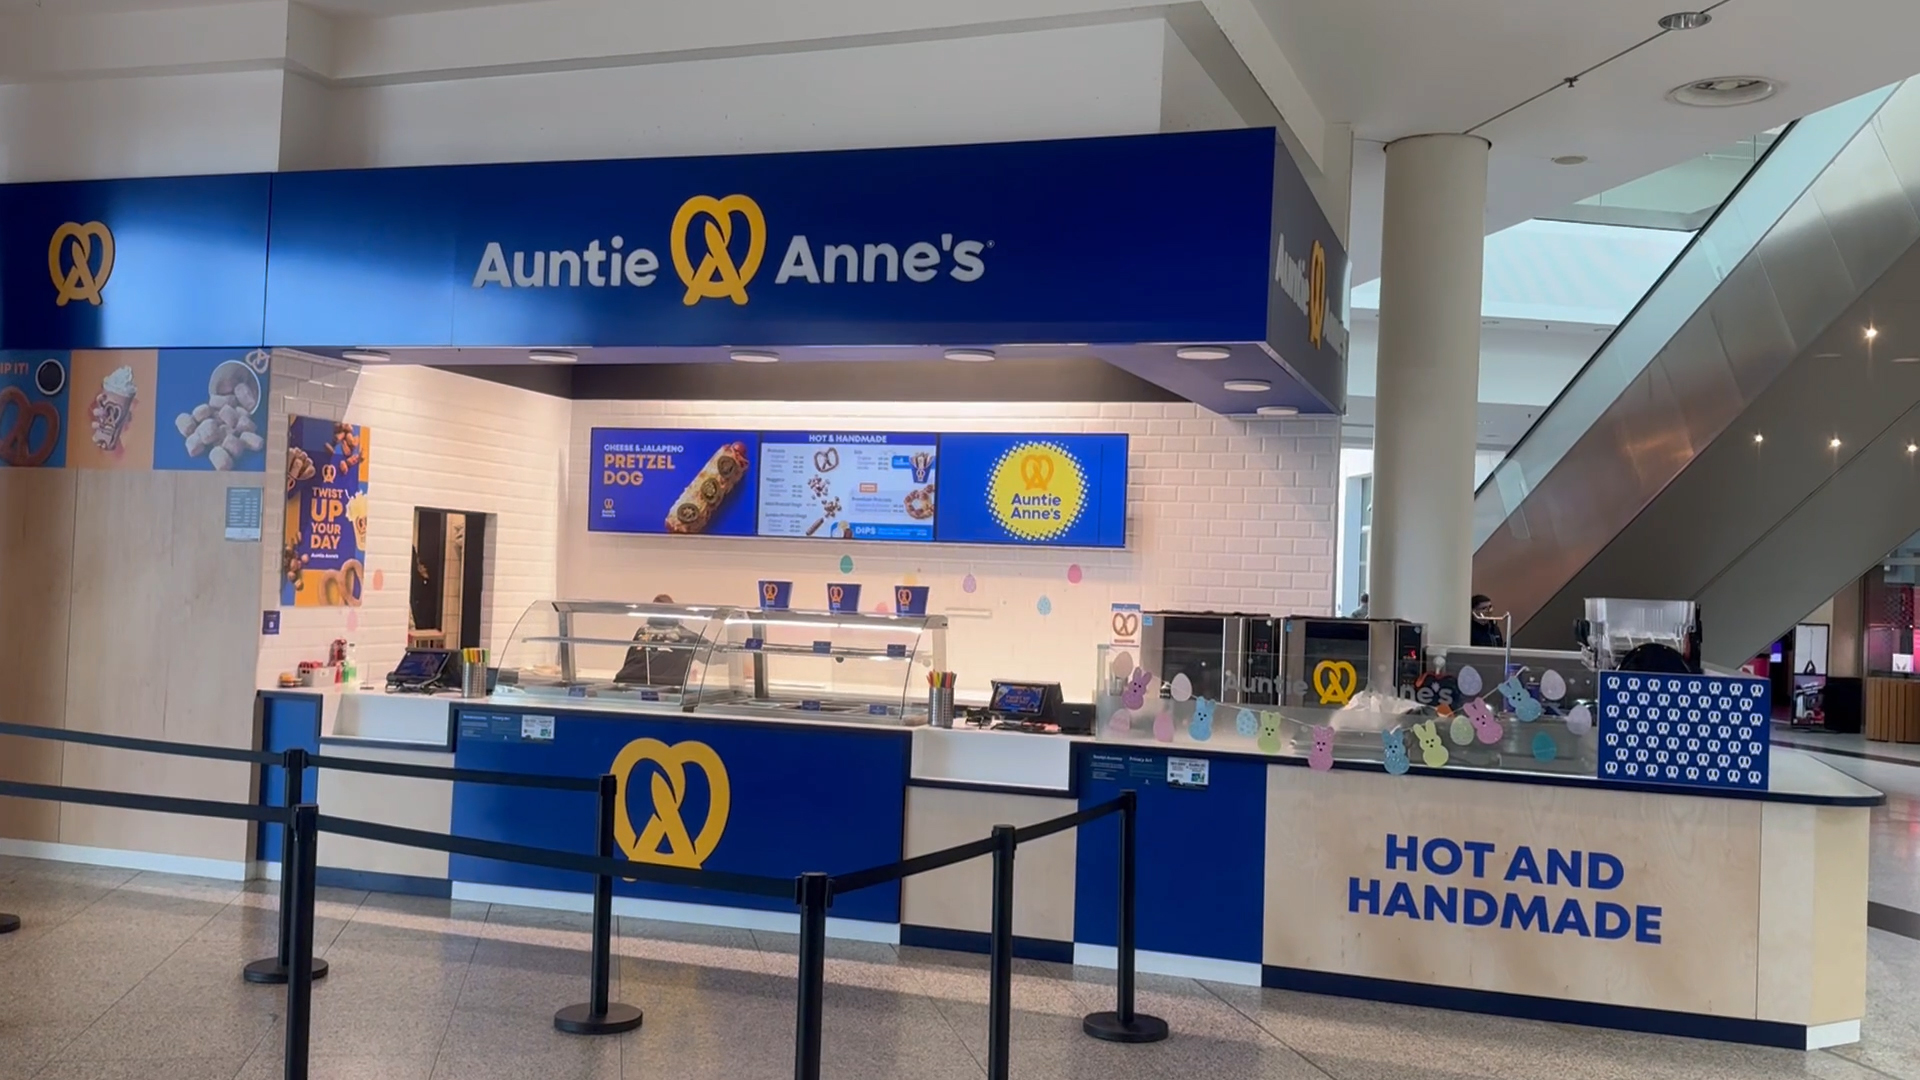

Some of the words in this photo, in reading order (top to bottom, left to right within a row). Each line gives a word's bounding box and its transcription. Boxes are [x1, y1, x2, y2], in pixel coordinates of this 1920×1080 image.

[473, 236, 659, 289] Auntie
[775, 233, 986, 285] Anne's
[0, 362, 12, 375] IP
[14, 362, 29, 375] IT!
[808, 434, 828, 442] HOT
[836, 435, 888, 444] HANDMADE
[603, 444, 634, 452] CHEESE
[603, 454, 675, 469] PRETZEL
[603, 470, 643, 485] DOG
[312, 488, 343, 499] TWIST
[1011, 493, 1062, 506] Auntie
[311, 499, 343, 522] UP
[1011, 507, 1061, 520] Anne's
[311, 523, 341, 535] YOUR
[855, 526, 877, 536] DIPS
[311, 535, 341, 550] DAY
[1224, 673, 1309, 697] Auntie
[1385, 833, 1495, 878] HOT
[1504, 845, 1625, 890] AND
[1348, 876, 1663, 945] HANDMADE
